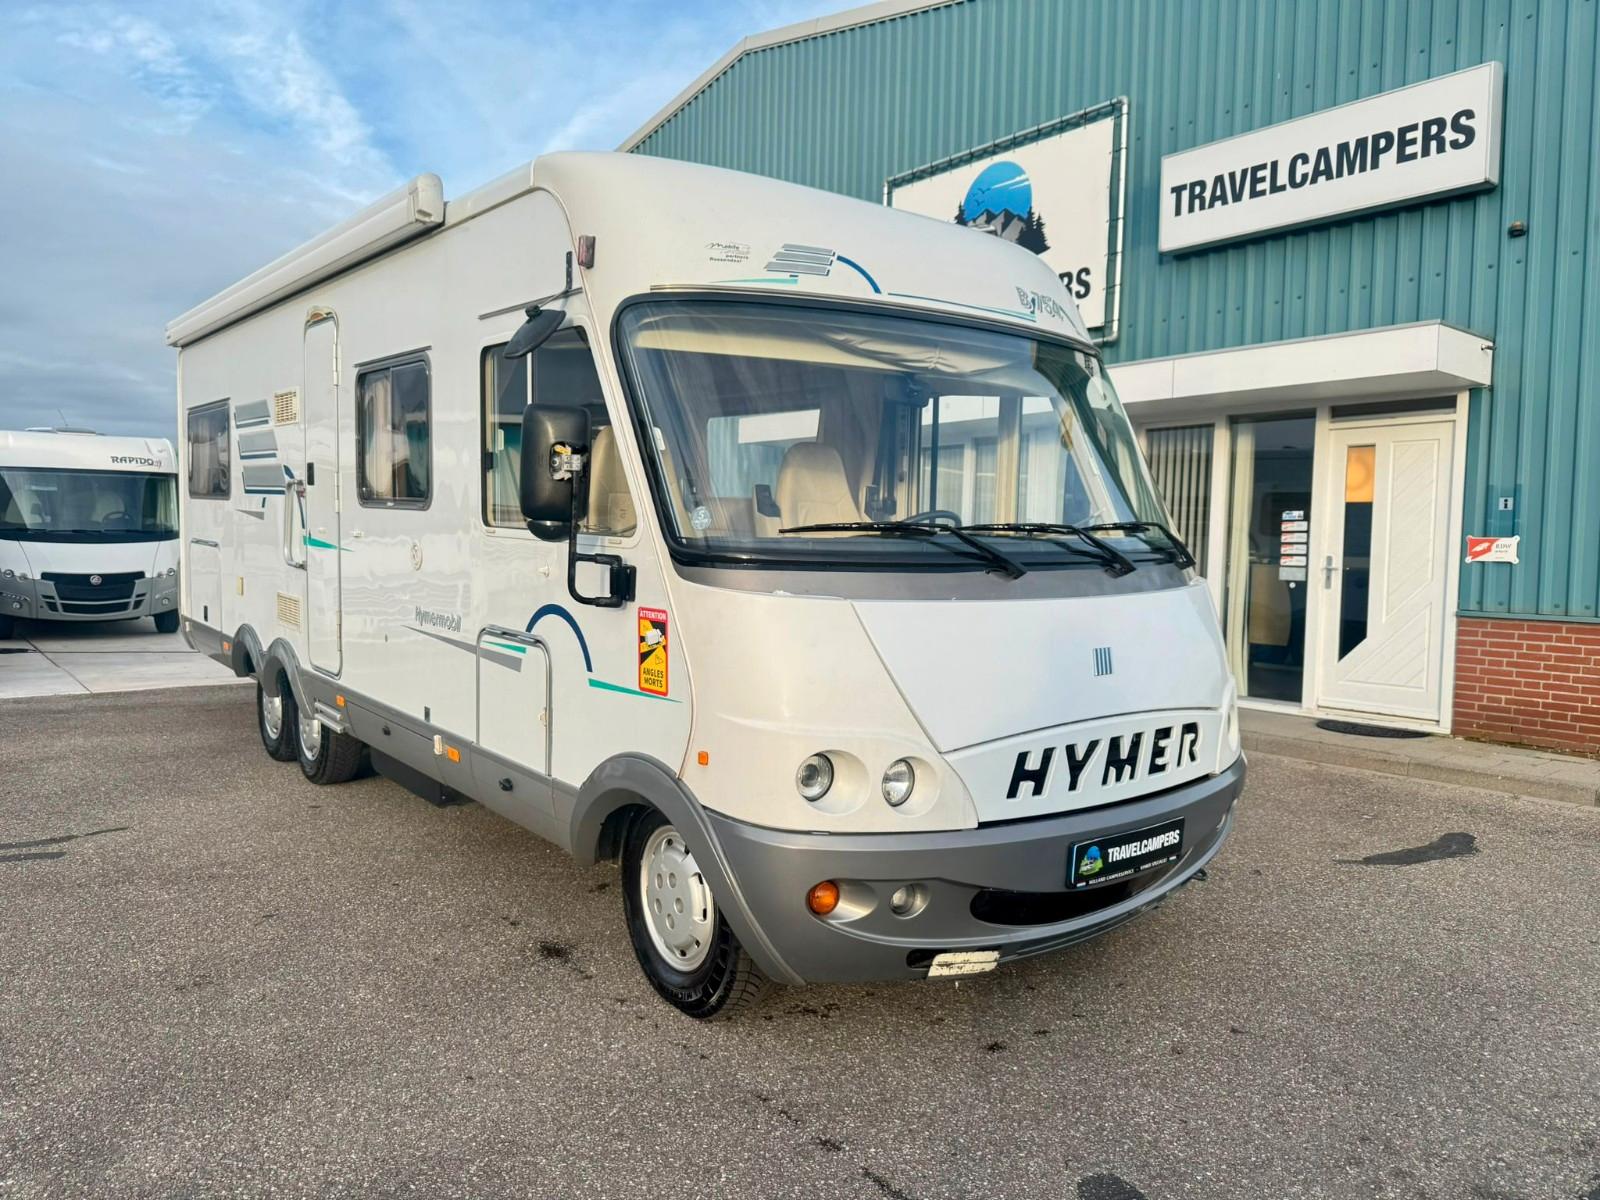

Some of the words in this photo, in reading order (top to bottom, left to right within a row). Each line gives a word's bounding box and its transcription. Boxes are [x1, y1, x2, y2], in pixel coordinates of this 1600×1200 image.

[1171, 108, 1476, 217] TRAVELCAMPERS
[110, 455, 154, 466] RAPIDO
[415, 605, 462, 632] Hymermobil
[640, 610, 666, 620] ATTENTION
[643, 667, 664, 679] ANGLES
[644, 676, 663, 688] MORTS
[1006, 722, 1199, 799] HYMER
[1107, 829, 1180, 863] TRAVELCAMPERS
